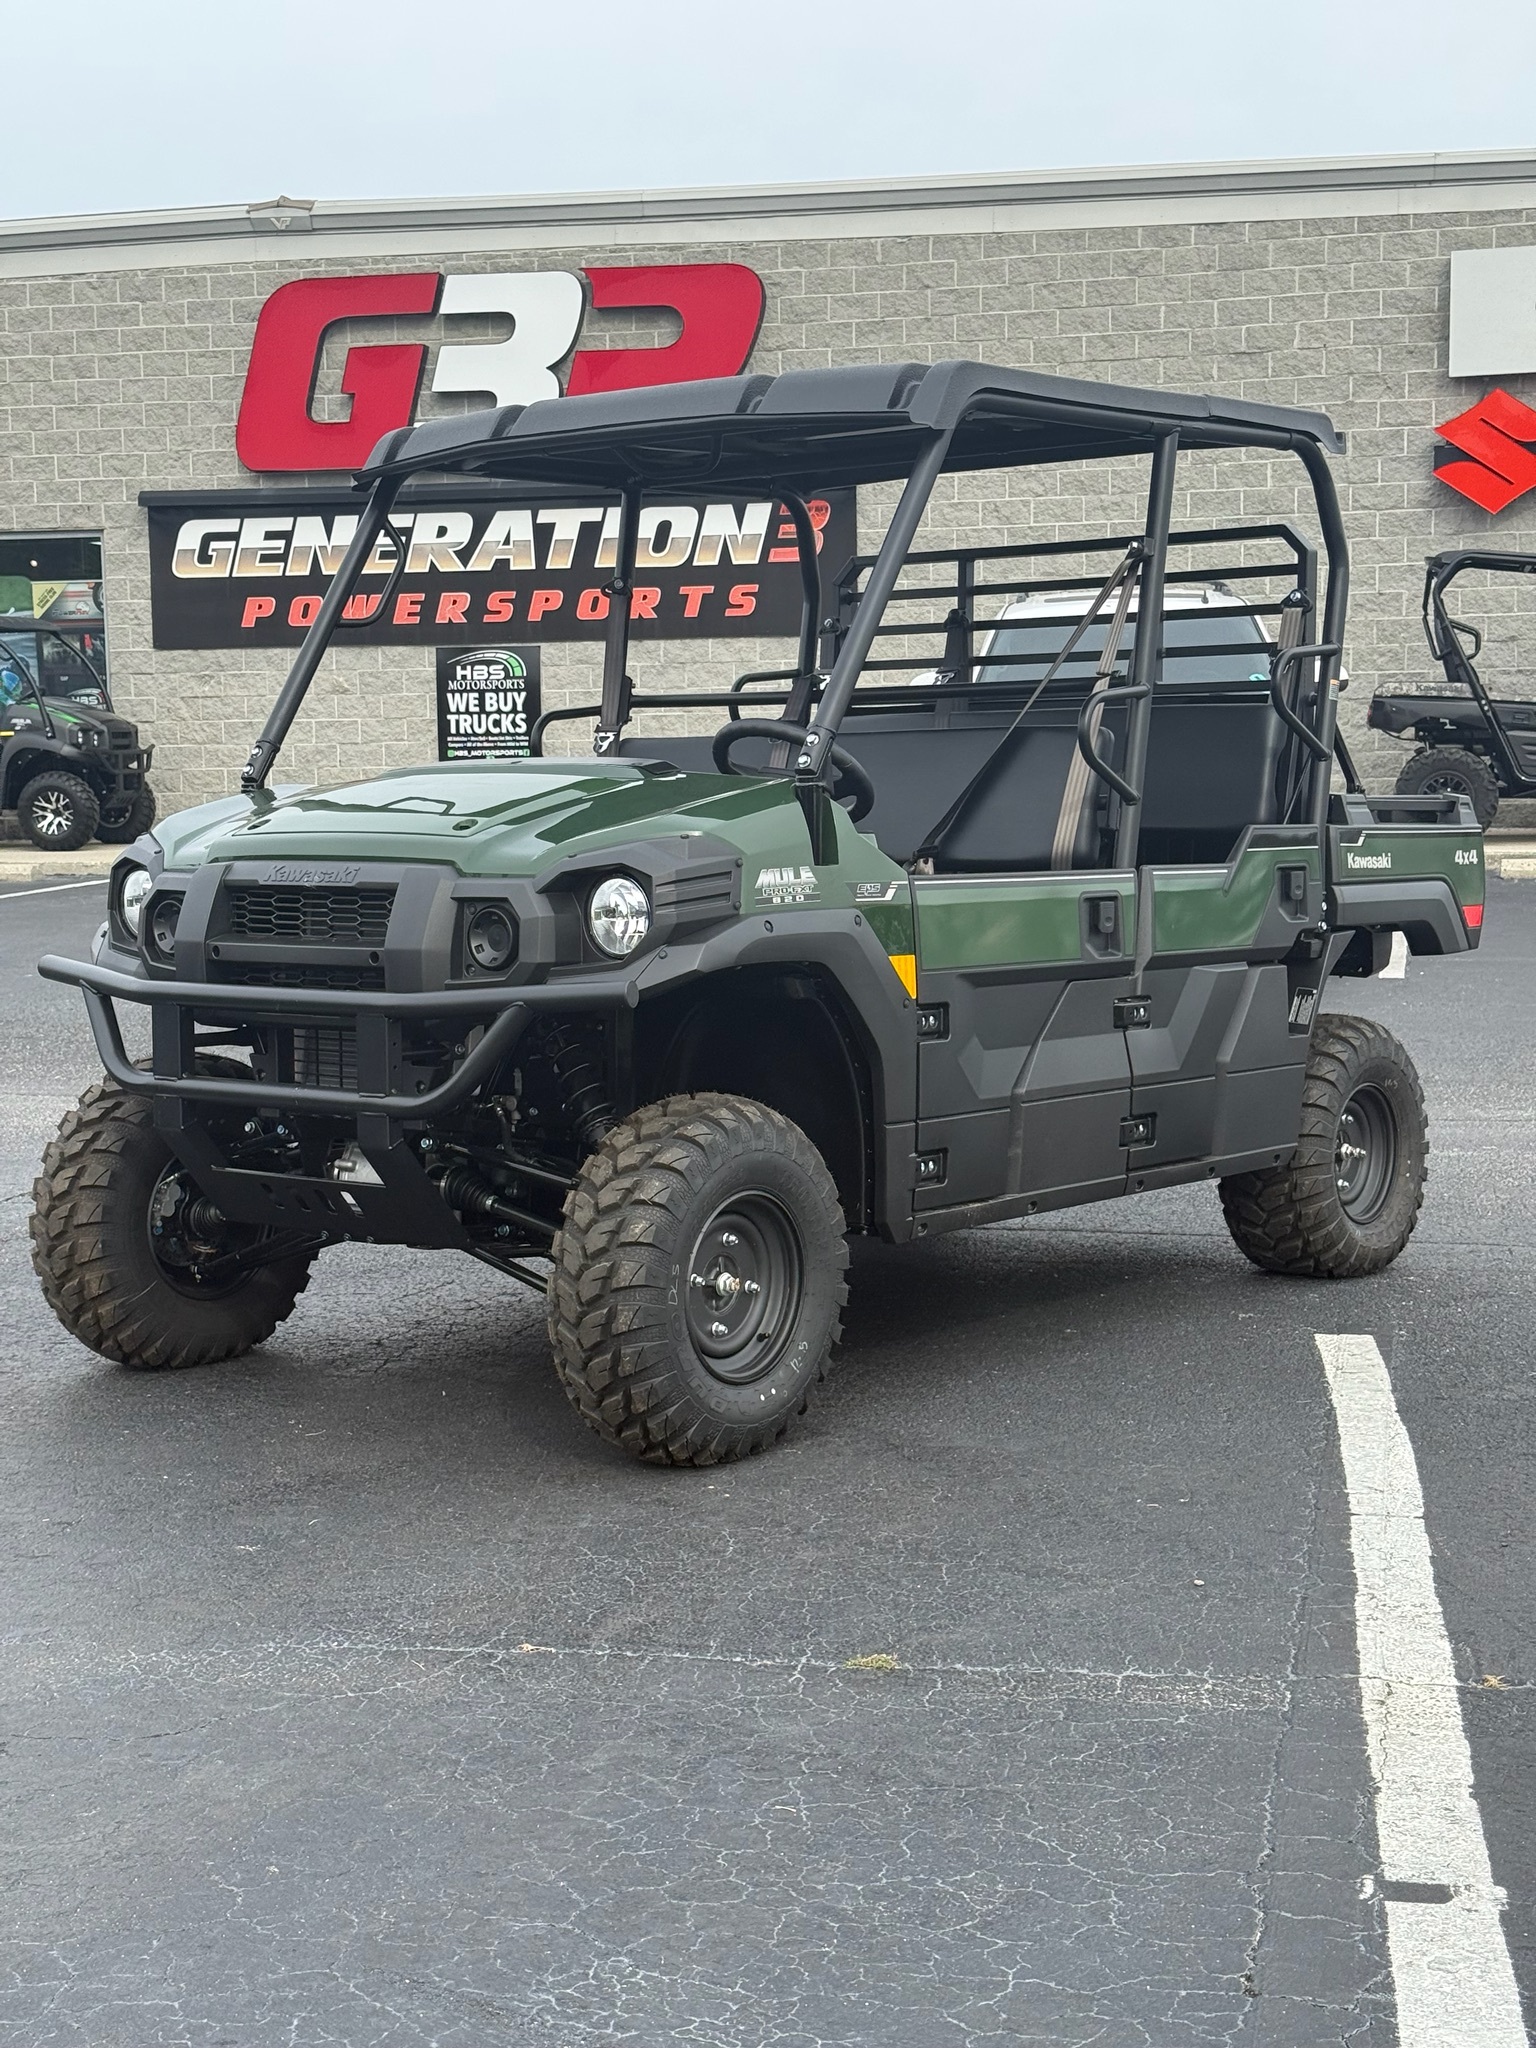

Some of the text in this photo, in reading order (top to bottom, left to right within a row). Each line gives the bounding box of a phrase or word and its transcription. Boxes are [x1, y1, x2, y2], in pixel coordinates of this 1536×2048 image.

[240, 584, 760, 628] POWERSPORTS
[456, 664, 506, 680] HBS
[447, 678, 525, 690] MOTORSPORTS
[446, 691, 527, 712] WE BUY
[446, 712, 527, 734] TRUCKS
[1347, 849, 1479, 869] Kawasaki 4x4
[263, 865, 361, 883] Kawasaki
[754, 866, 819, 889] MULE
